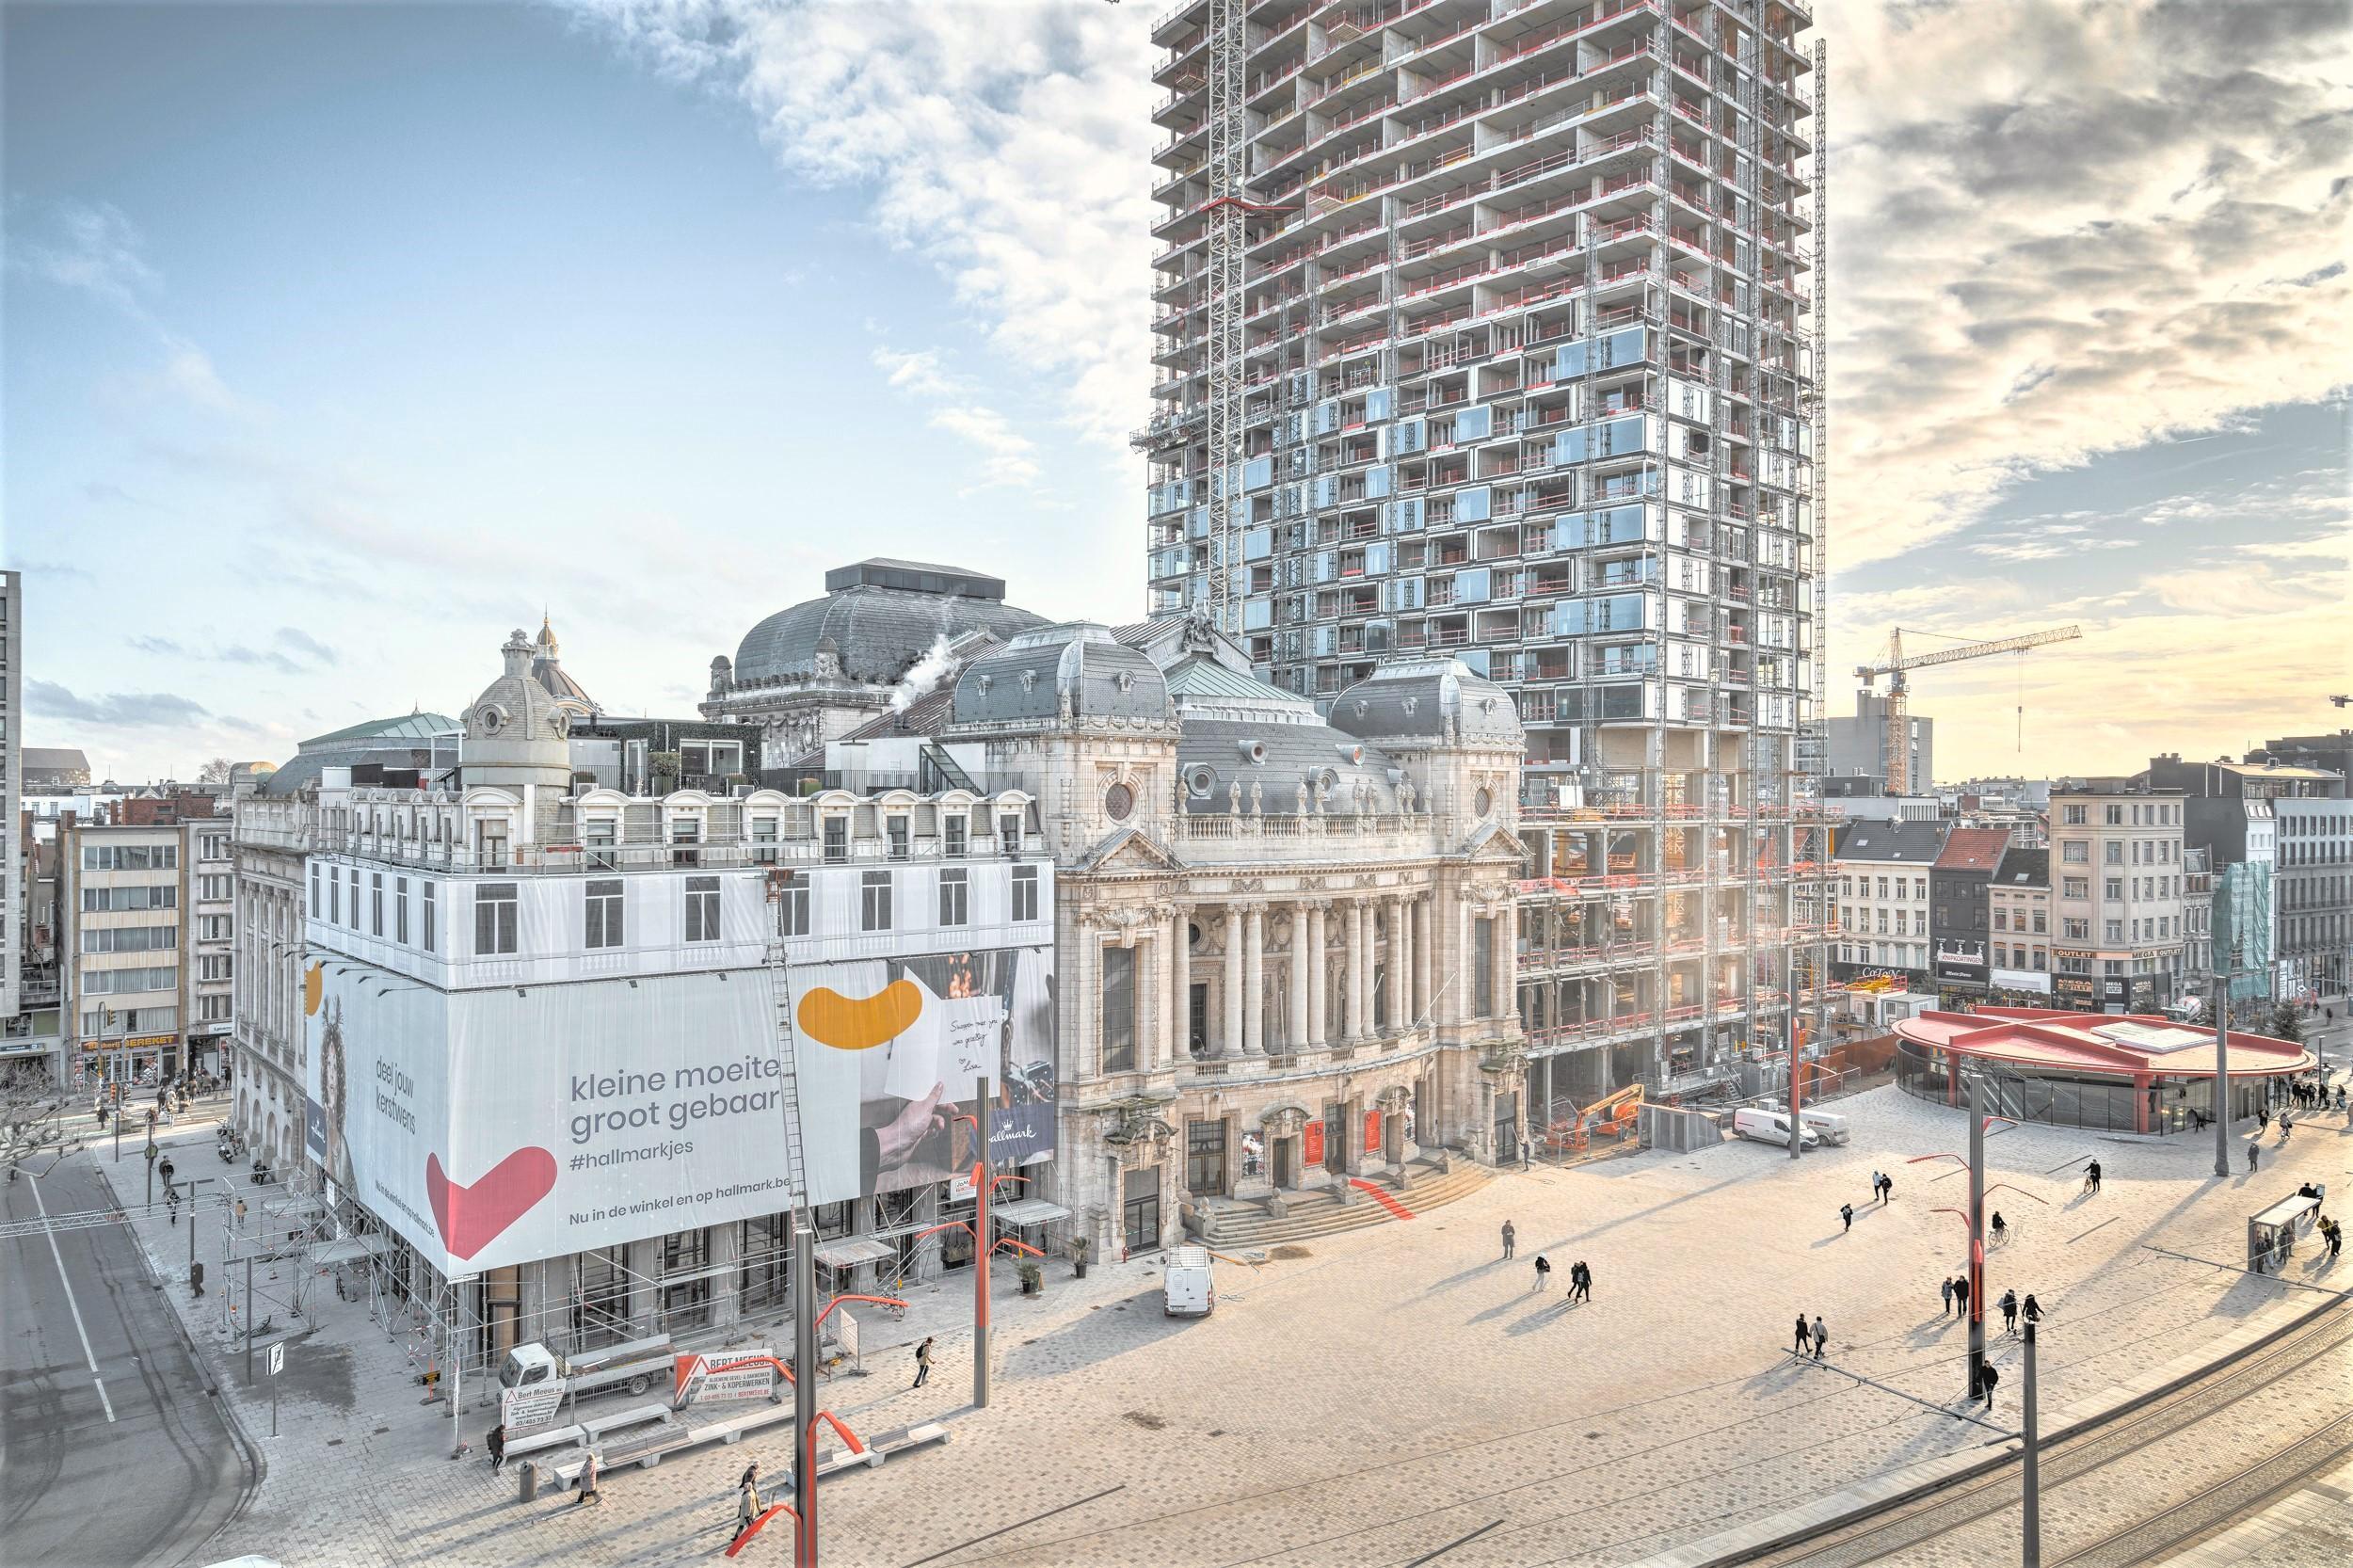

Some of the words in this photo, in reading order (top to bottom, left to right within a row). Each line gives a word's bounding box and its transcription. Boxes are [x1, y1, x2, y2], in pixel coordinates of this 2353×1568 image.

[2159, 948, 2182, 956] OUTLET
[376, 1055, 393, 1086] deel
[394, 1063, 414, 1098] jouw
[571, 1069, 666, 1102] kleine
[675, 1055, 780, 1088] moeite
[376, 1085, 415, 1135] kerstwens
[570, 1102, 661, 1144] groot
[669, 1090, 780, 1130] gebaar
[988, 1124, 1036, 1143] allmark
[569, 1140, 694, 1172] #hallmarkjes
[569, 1213, 589, 1225] Nu
[592, 1208, 605, 1221] in
[608, 1205, 627, 1219] de
[630, 1195, 674, 1214] winkel
[677, 1193, 693, 1206] en
[696, 1191, 713, 1204] op
[715, 1177, 791, 1199] hallmark.be
[533, 1388, 554, 1397] Meeus
[705, 1382, 720, 1391] ZINK-
[721, 1382, 727, 1390] &
[728, 1378, 770, 1389] KOPERWERKEN
